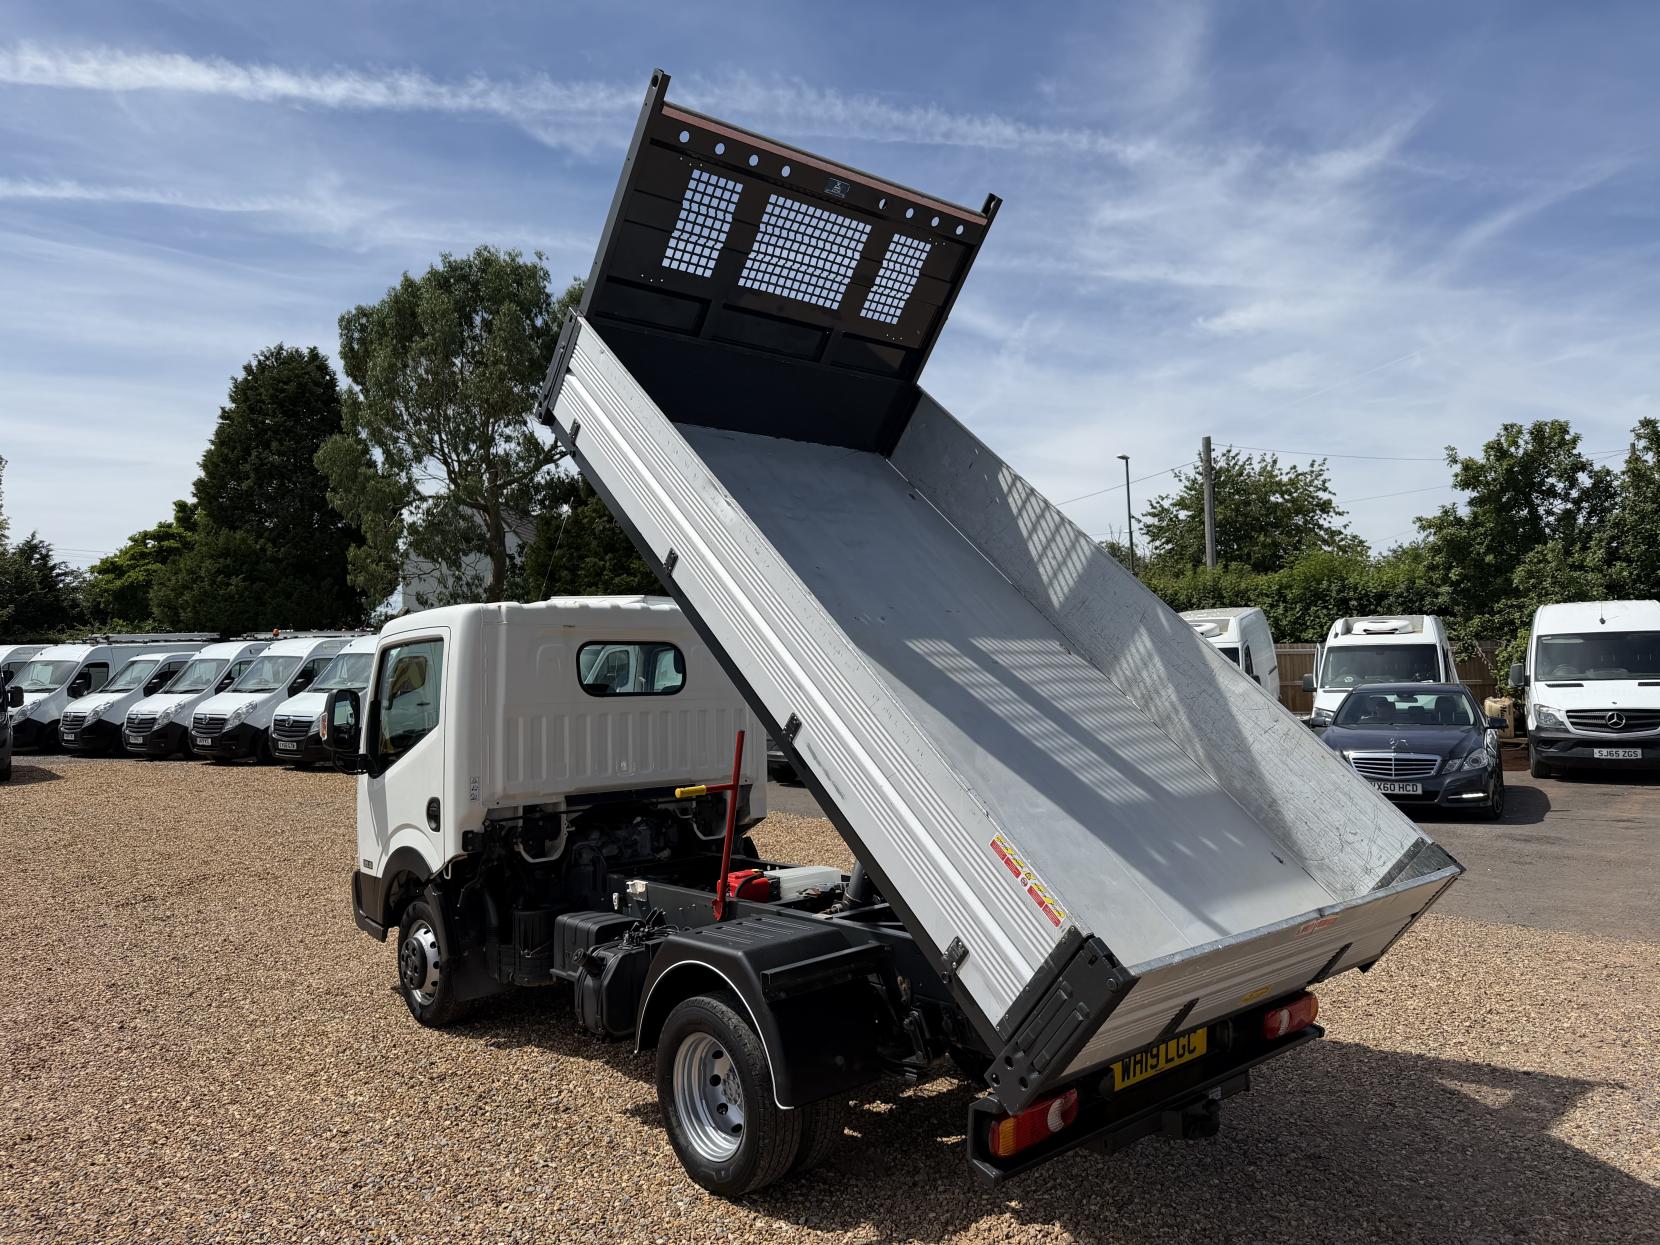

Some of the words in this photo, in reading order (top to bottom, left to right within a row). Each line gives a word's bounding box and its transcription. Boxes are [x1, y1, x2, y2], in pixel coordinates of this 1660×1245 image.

[1598, 750, 1620, 758] SJ65
[1398, 783, 1418, 793] HCD
[1165, 1032, 1197, 1065] LGC
